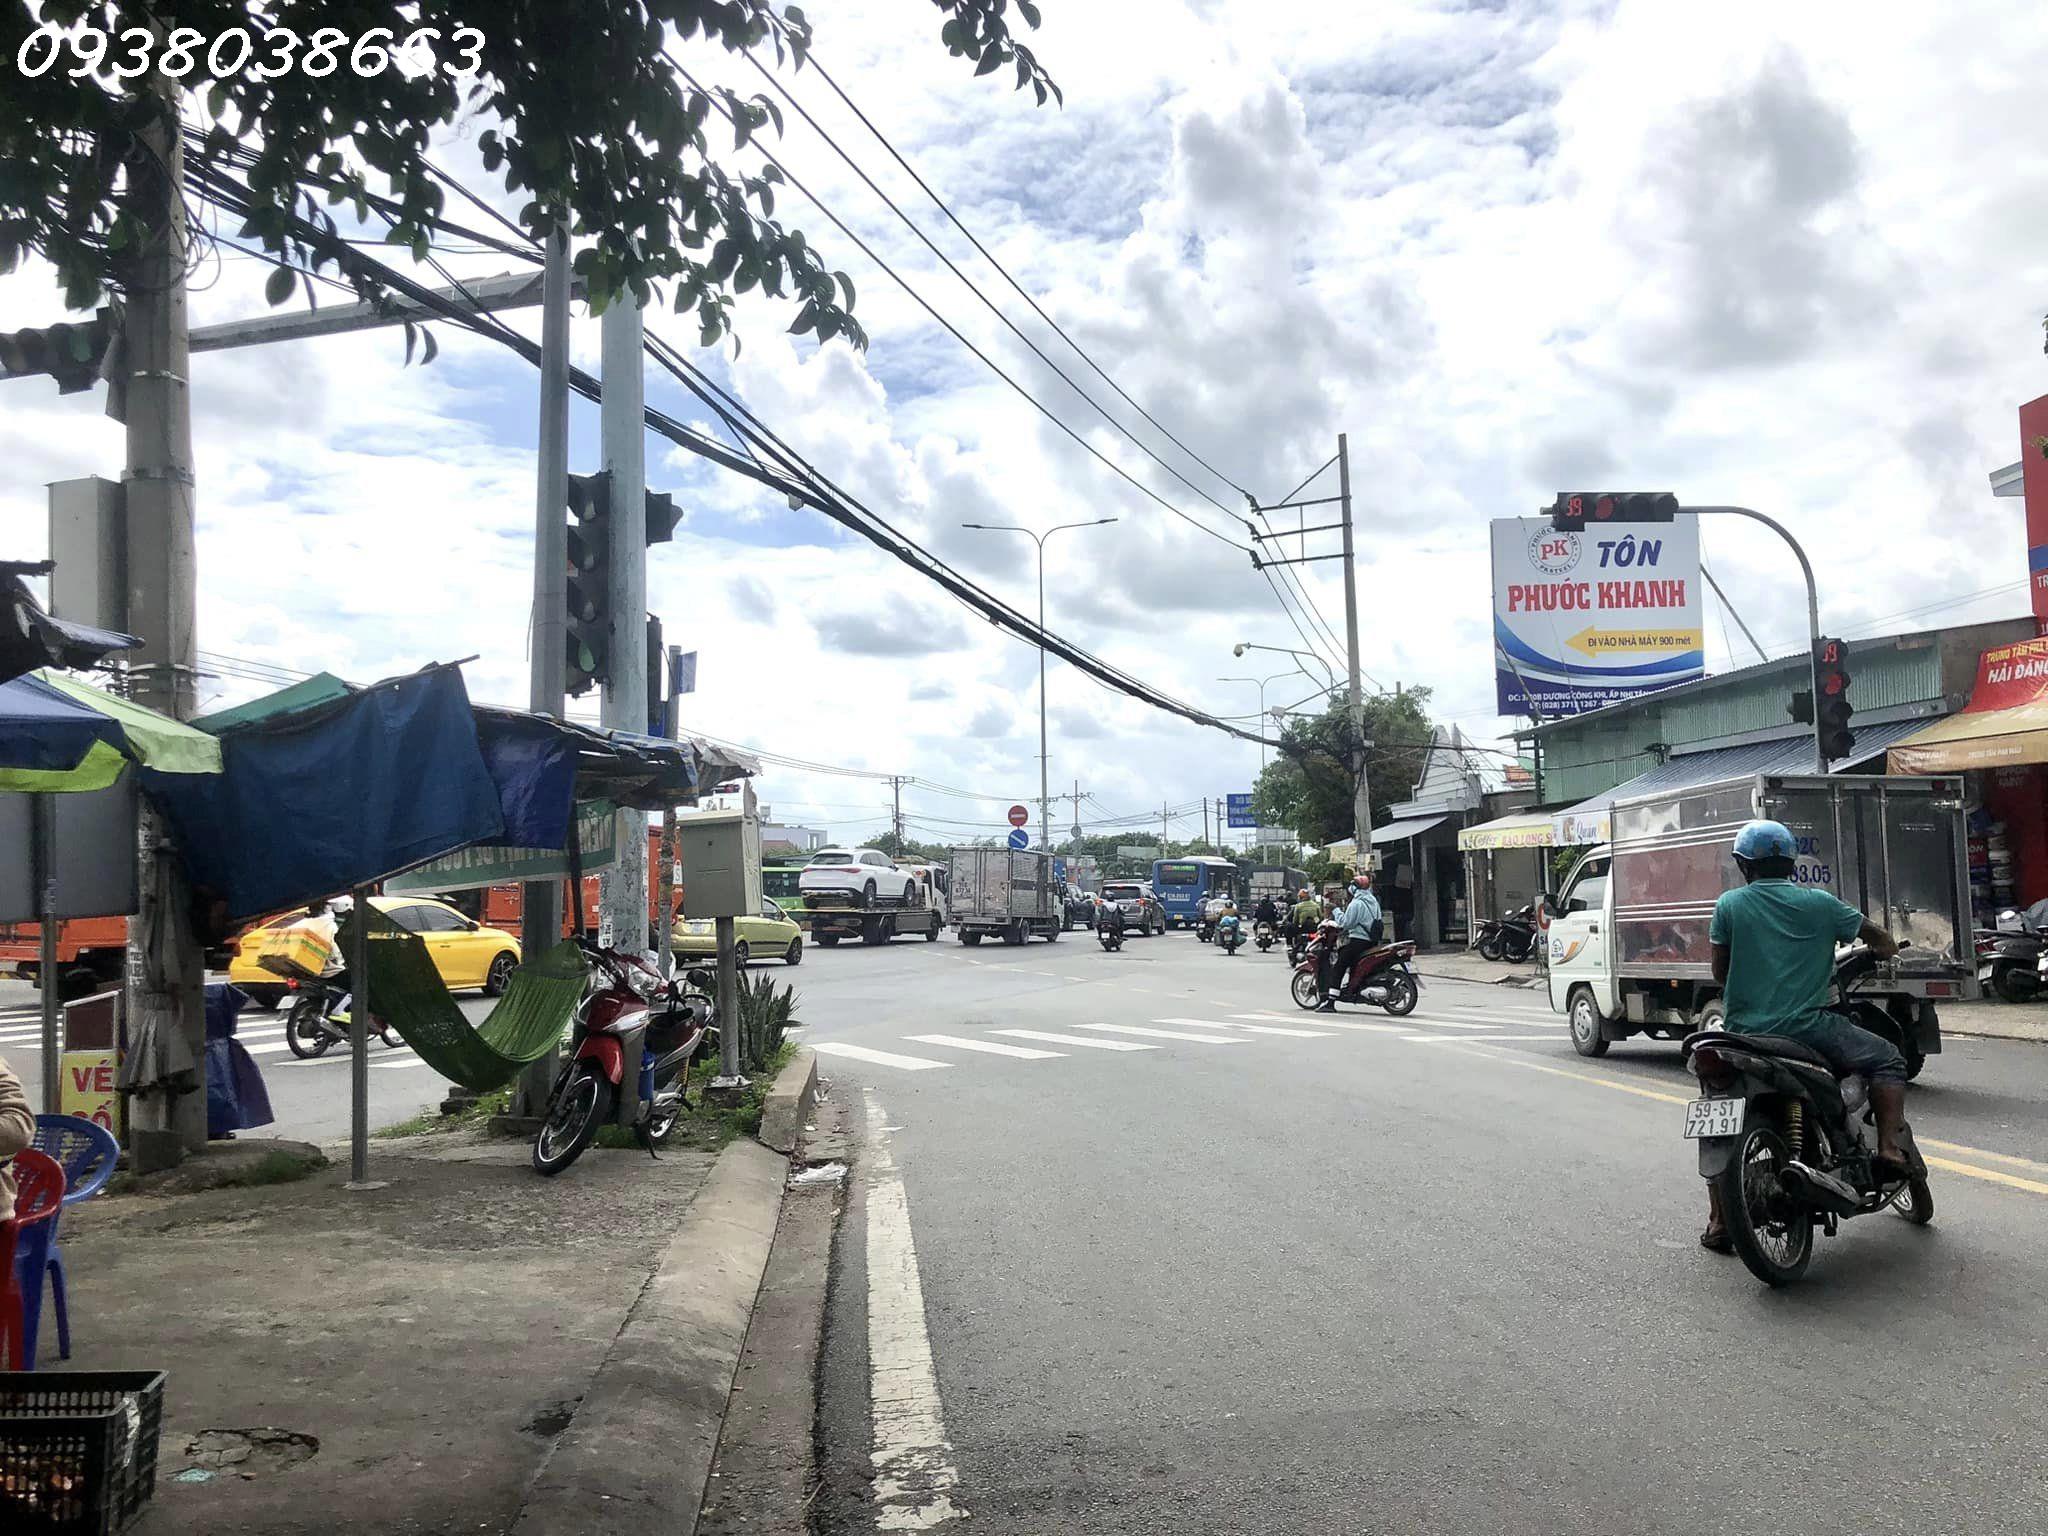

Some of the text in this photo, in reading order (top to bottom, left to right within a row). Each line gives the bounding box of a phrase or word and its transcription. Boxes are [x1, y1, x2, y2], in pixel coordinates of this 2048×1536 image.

[1541, 539, 1569, 561] PK
[1597, 534, 1662, 568] TÔN
[1508, 577, 1687, 612] PHƯỚC KHANH
[1588, 633, 1691, 648] ĐI VÀO NHÀ MÁY 900 mét
[1987, 661, 2011, 684] HẢI
[1694, 1100, 1735, 1118] 59-S1
[1687, 1117, 1738, 1136] 721.91
